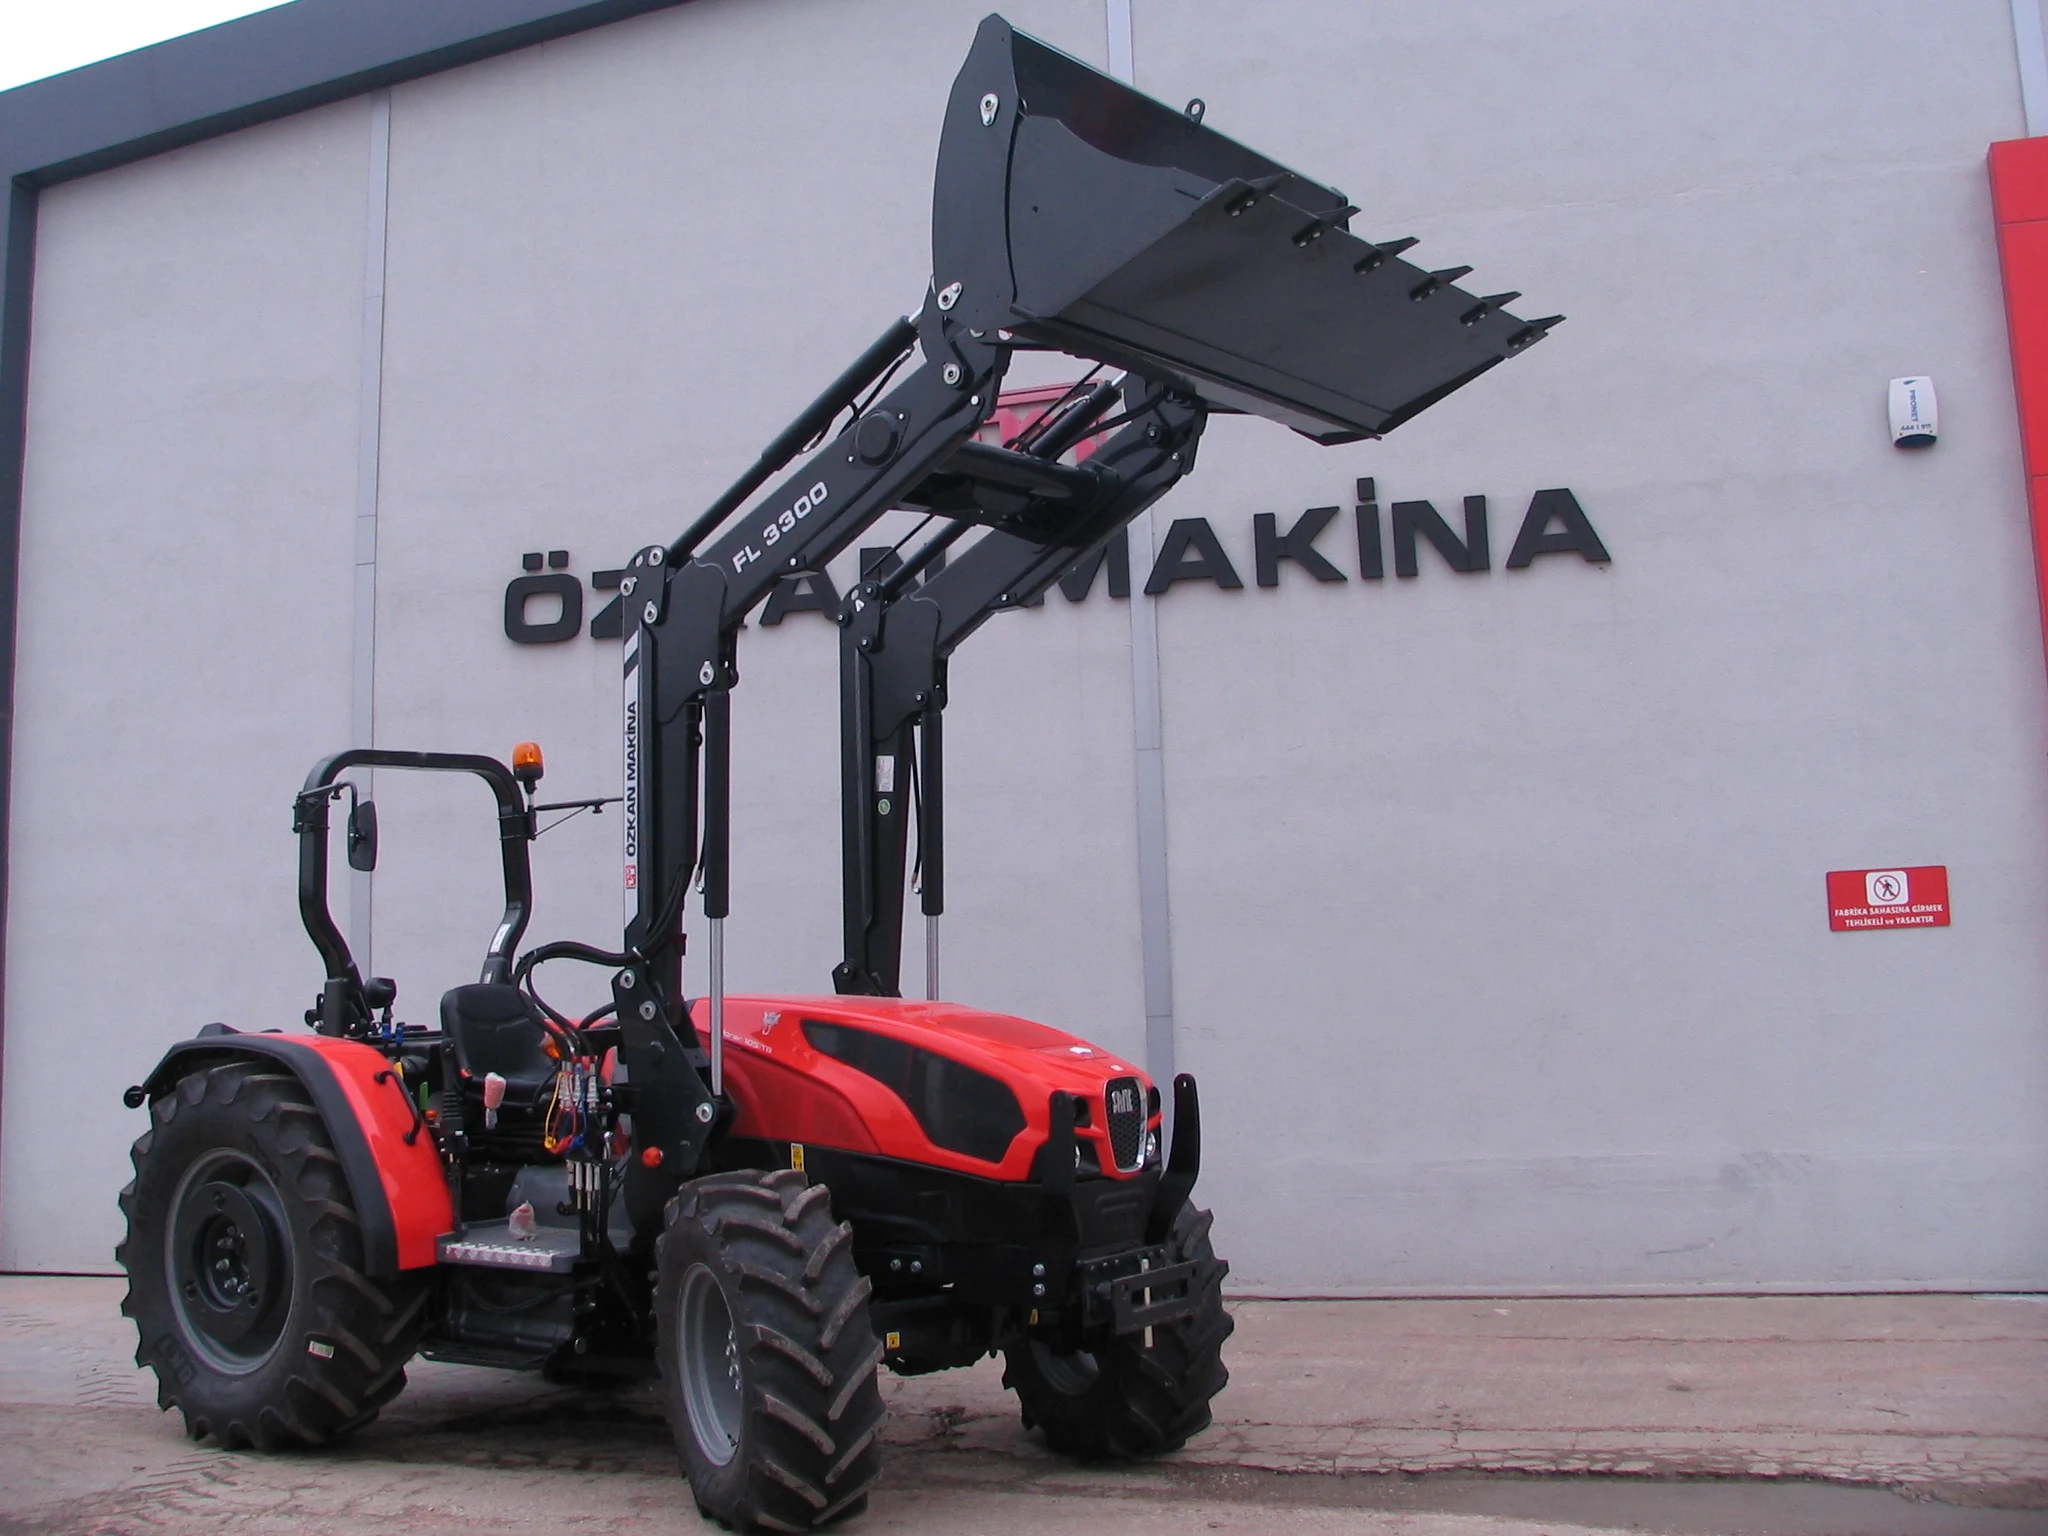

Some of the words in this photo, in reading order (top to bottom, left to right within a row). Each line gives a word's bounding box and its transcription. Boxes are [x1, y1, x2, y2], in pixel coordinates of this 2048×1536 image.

[732, 545, 761, 573] FL
[763, 481, 828, 546] 3300
[625, 701, 636, 781] MAKİNA
[625, 787, 636, 857] ÖZKAN
